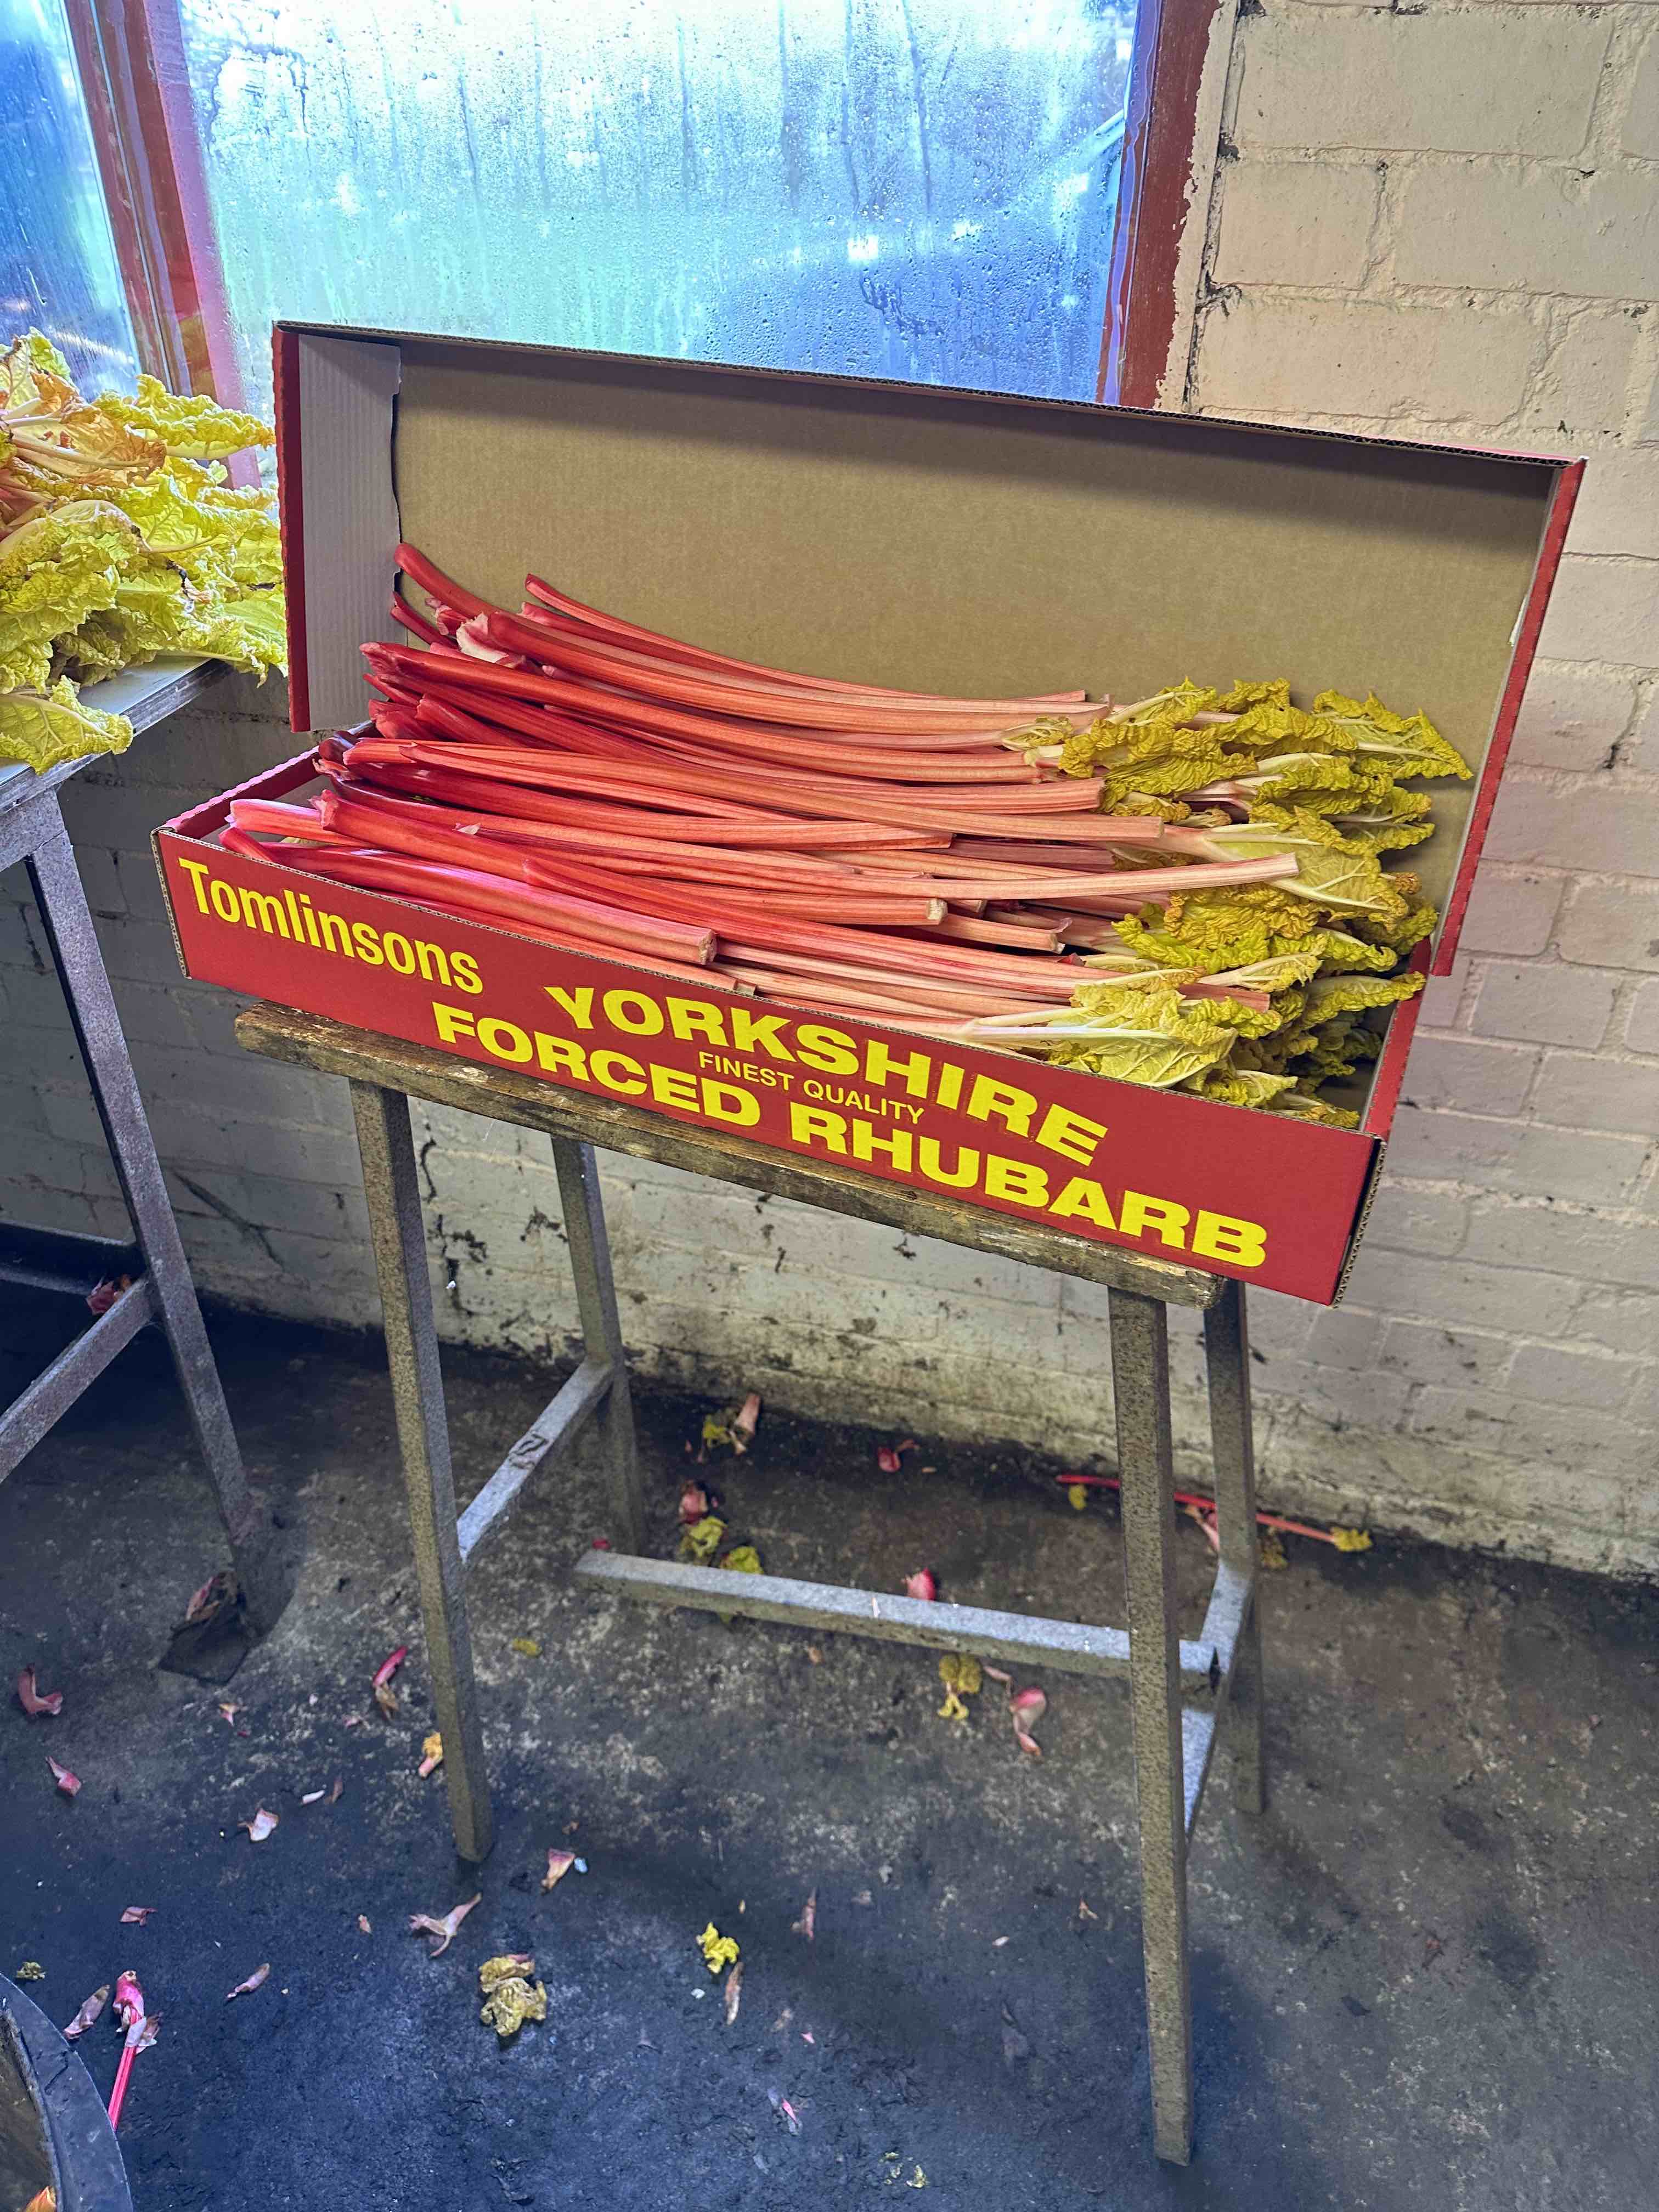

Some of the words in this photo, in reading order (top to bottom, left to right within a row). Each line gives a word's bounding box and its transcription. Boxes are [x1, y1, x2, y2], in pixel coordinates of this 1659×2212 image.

[178, 857, 483, 995] Tomlinsons
[431, 1001, 761, 1126] FORCED
[789, 1101, 1267, 1267] RHUBARB
[544, 986, 1109, 1167] YORKSHIRE
[698, 1051, 795, 1091] FINEST
[803, 1079, 925, 1125] QUALITY
